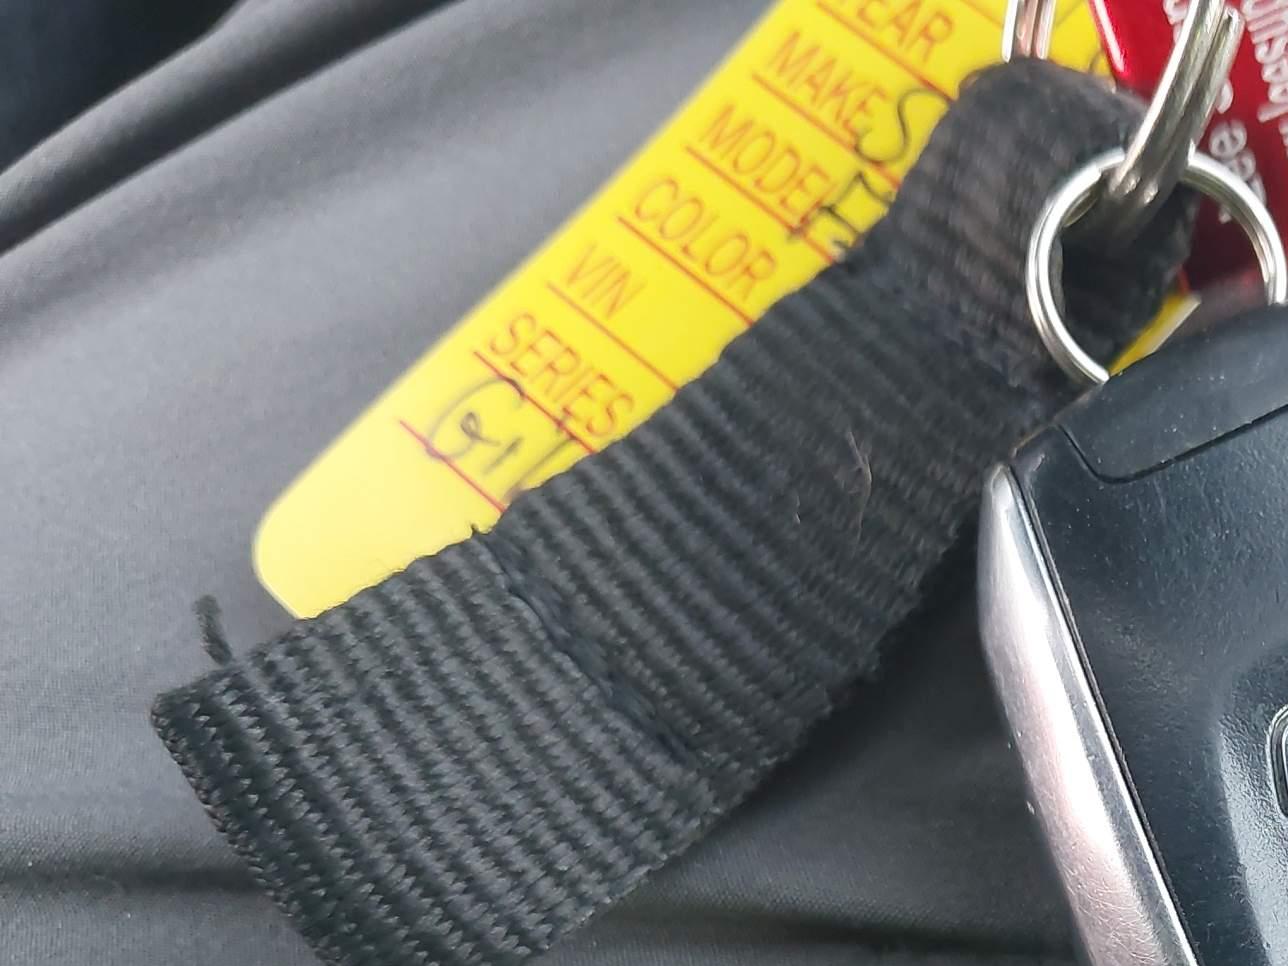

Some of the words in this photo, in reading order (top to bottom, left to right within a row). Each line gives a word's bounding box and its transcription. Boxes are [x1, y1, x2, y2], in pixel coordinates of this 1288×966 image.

[767, 29, 888, 135] MAKE
[698, 101, 840, 232] MODEL
[566, 242, 647, 320] VIN
[632, 175, 776, 302] COLOR
[488, 312, 636, 438] SERIES
